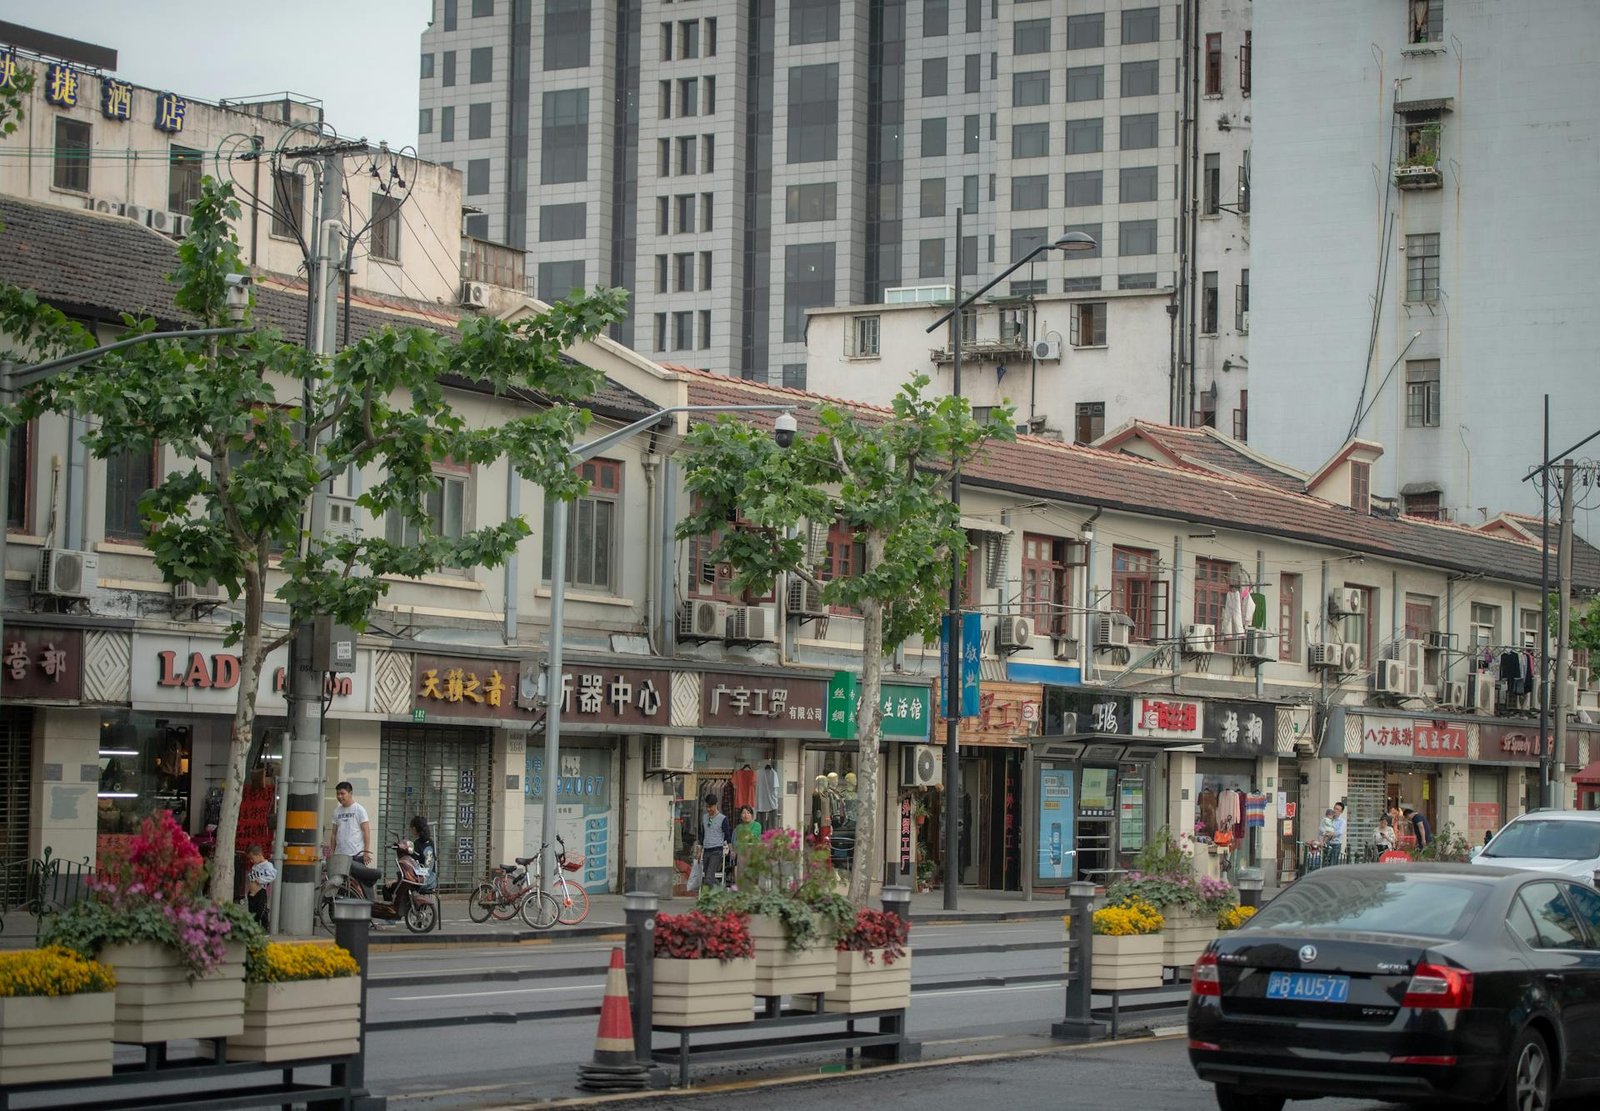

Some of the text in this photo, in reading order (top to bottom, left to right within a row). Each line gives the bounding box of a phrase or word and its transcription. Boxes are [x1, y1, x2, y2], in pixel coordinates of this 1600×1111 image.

[4, 641, 67, 682] 营部
[160, 651, 241, 688] LAD
[711, 684, 821, 720] 广宇工贸 有限公司
[1365, 726, 1414, 747] 八方旅游
[525, 776, 605, 796] 6394067
